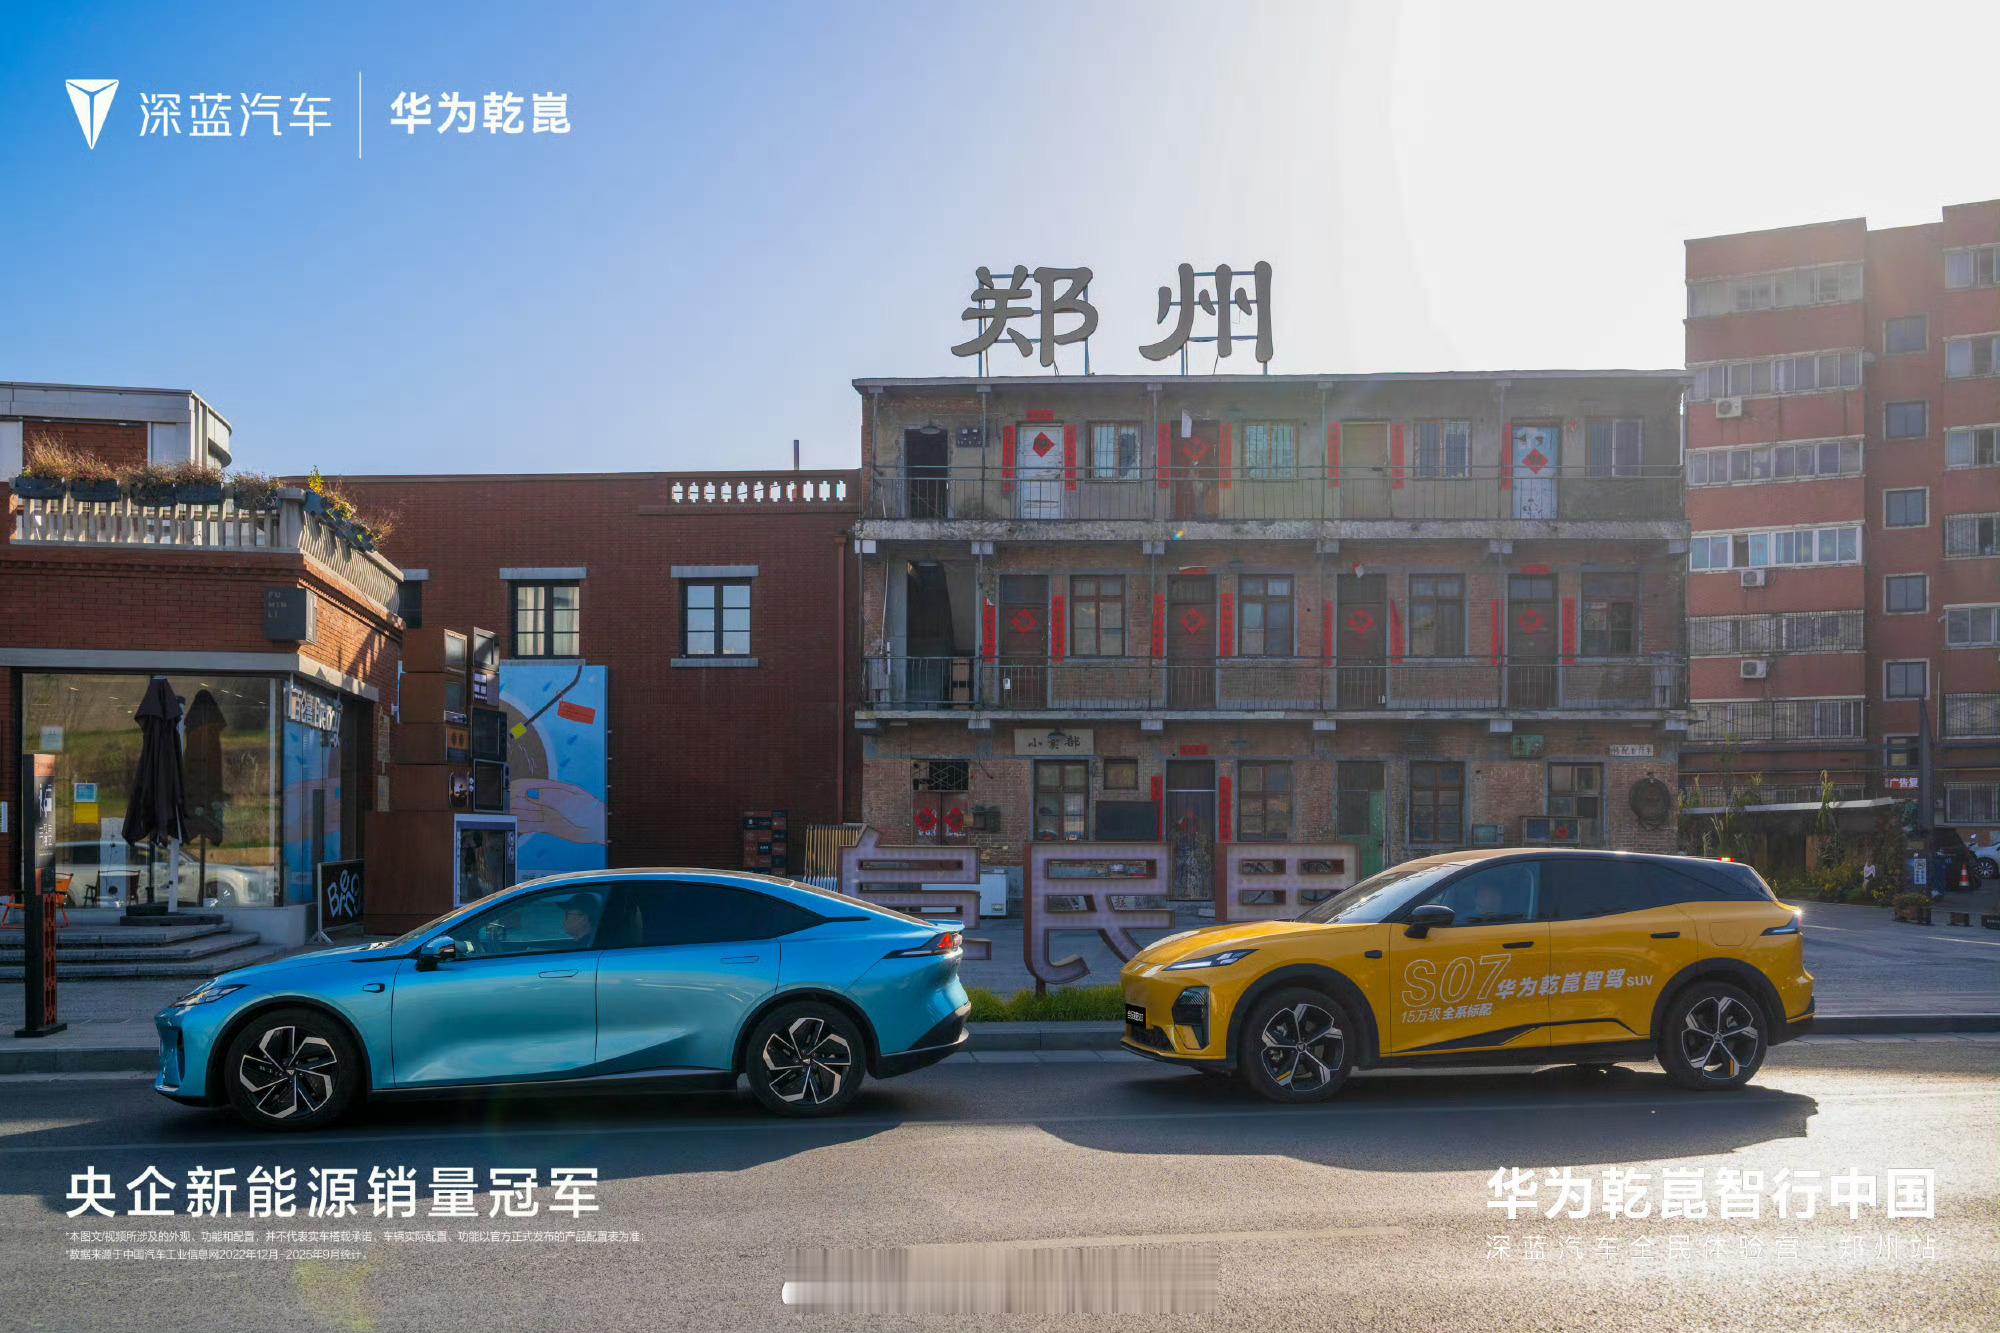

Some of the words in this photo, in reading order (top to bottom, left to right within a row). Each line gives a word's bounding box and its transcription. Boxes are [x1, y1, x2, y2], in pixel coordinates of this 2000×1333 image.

[951, 260, 1273, 367] 郑州
[1402, 953, 1511, 1008] S07
[1496, 968, 1626, 1000] 华为乾崑智驾
[1627, 975, 1653, 987] SUV
[1401, 1008, 1441, 1023] 15万级
